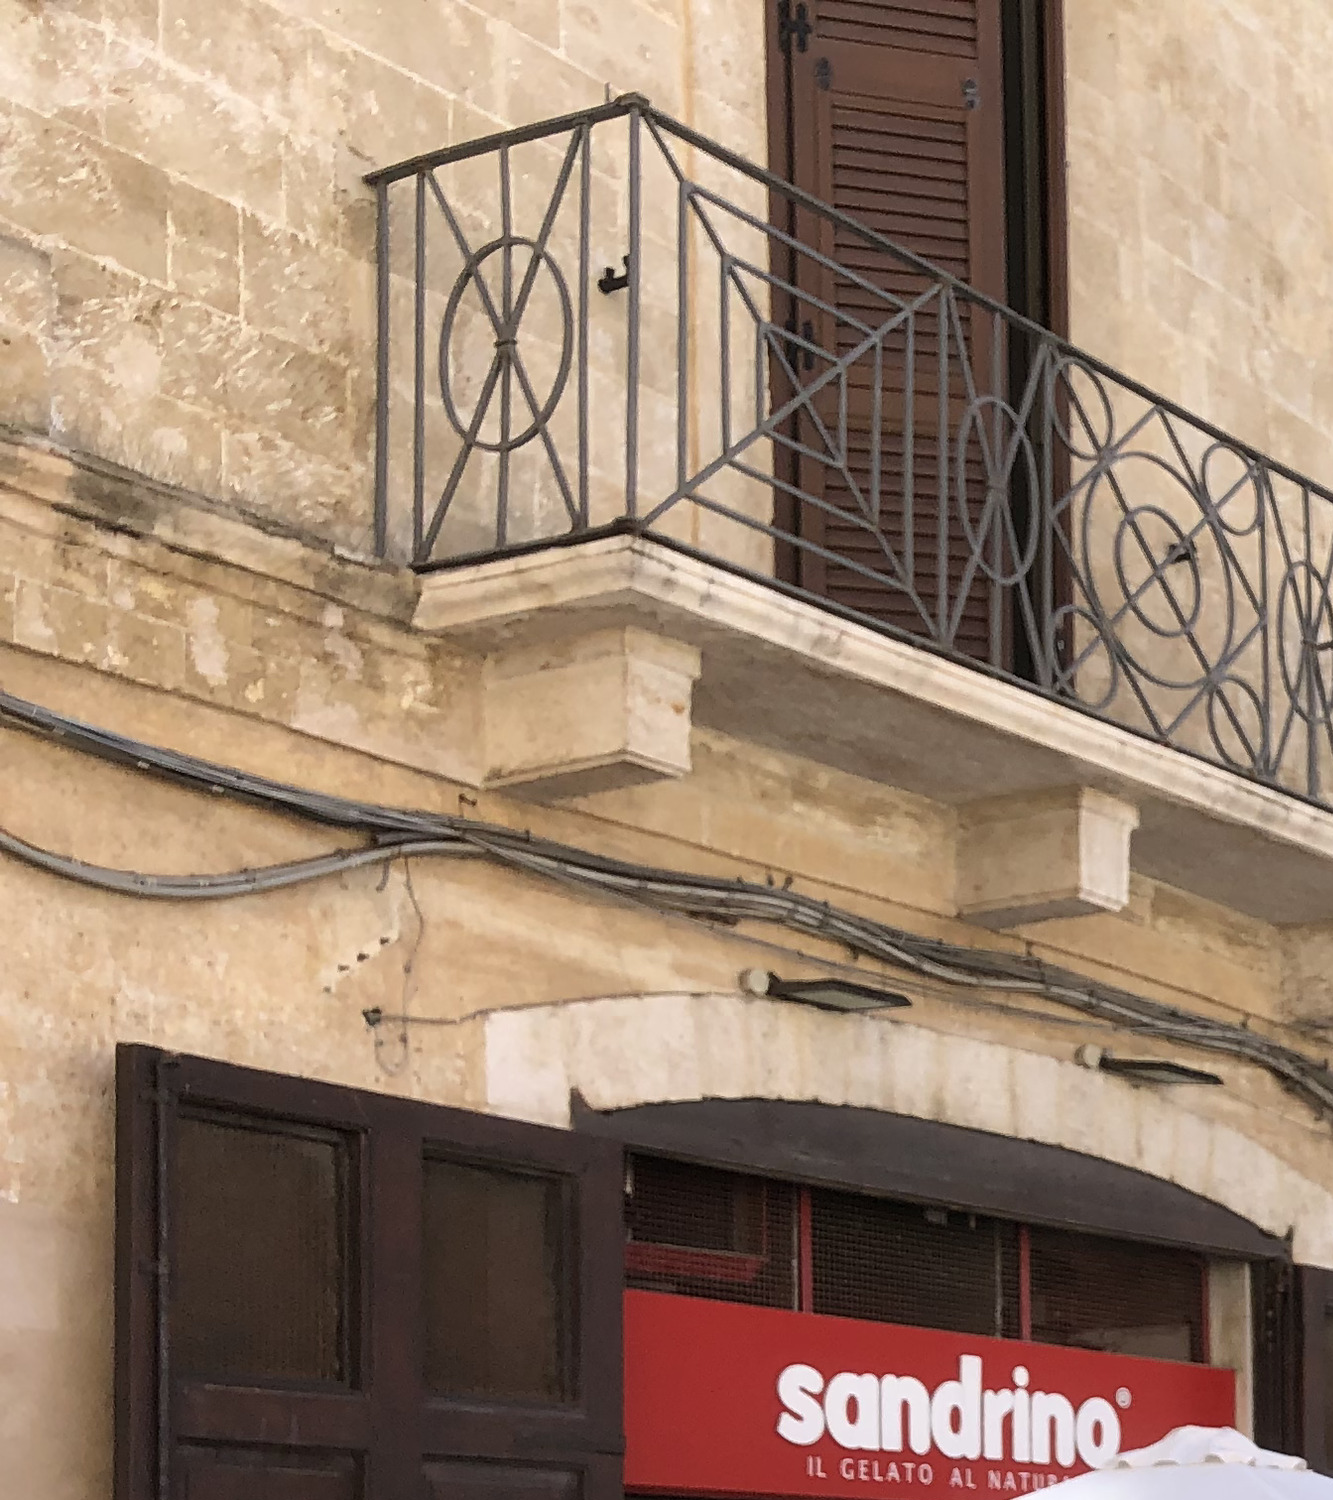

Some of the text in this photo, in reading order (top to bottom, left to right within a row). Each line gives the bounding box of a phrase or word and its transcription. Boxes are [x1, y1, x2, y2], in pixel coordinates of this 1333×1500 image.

[777, 1353, 1122, 1470] sandrino
[805, 1455, 1069, 1492] IL GELATO AL NATUR
